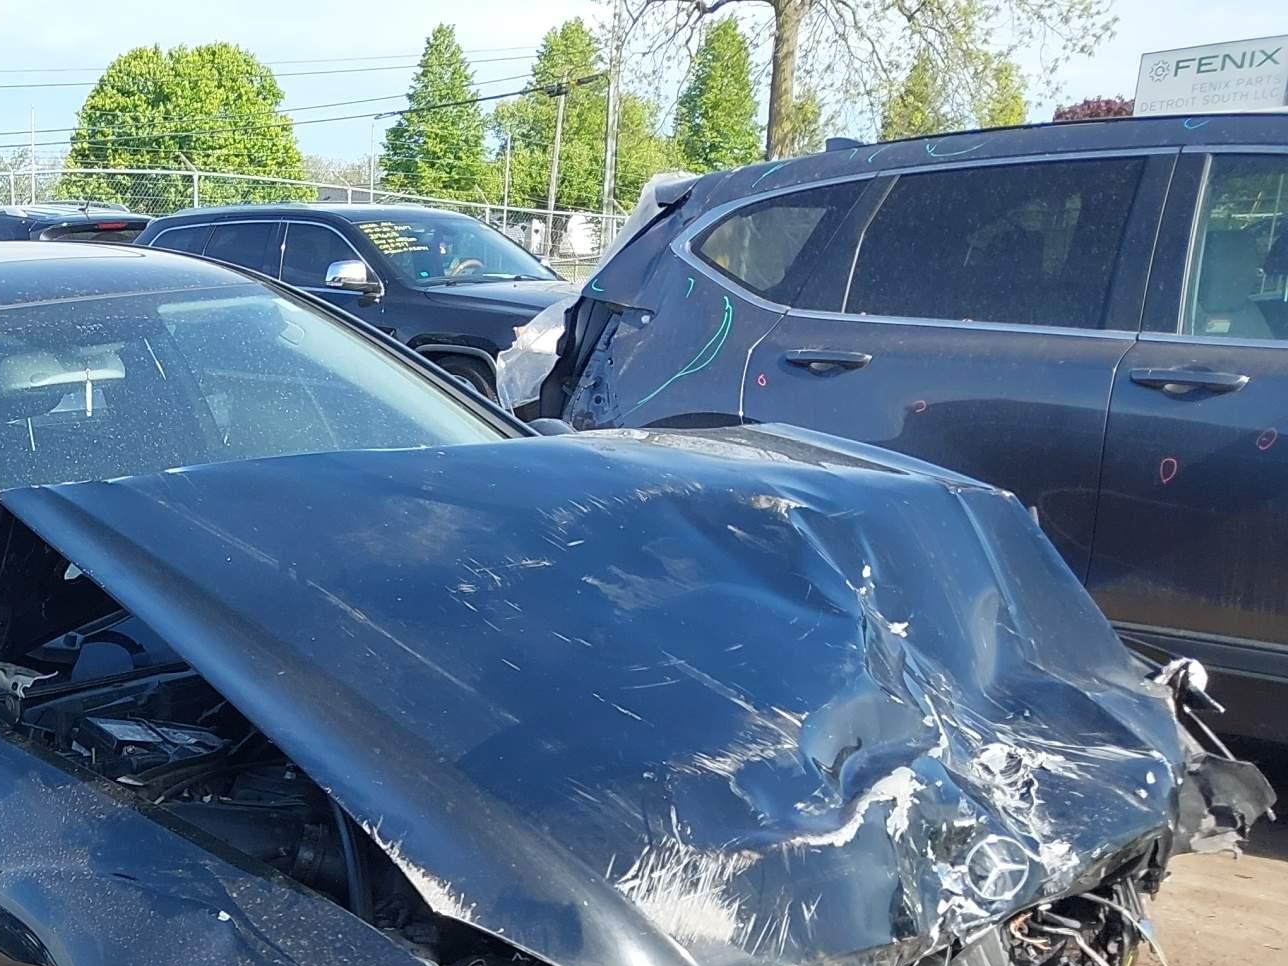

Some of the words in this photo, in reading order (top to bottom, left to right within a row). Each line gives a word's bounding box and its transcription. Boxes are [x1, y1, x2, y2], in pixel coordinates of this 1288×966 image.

[1173, 46, 1283, 77] FENIX
[1191, 79, 1232, 94] FENIX
[1236, 74, 1282, 89] PARTS
[1140, 96, 1198, 113] DETROIT
[1203, 91, 1249, 105] SOUTH
[1255, 87, 1281, 100] LLC
